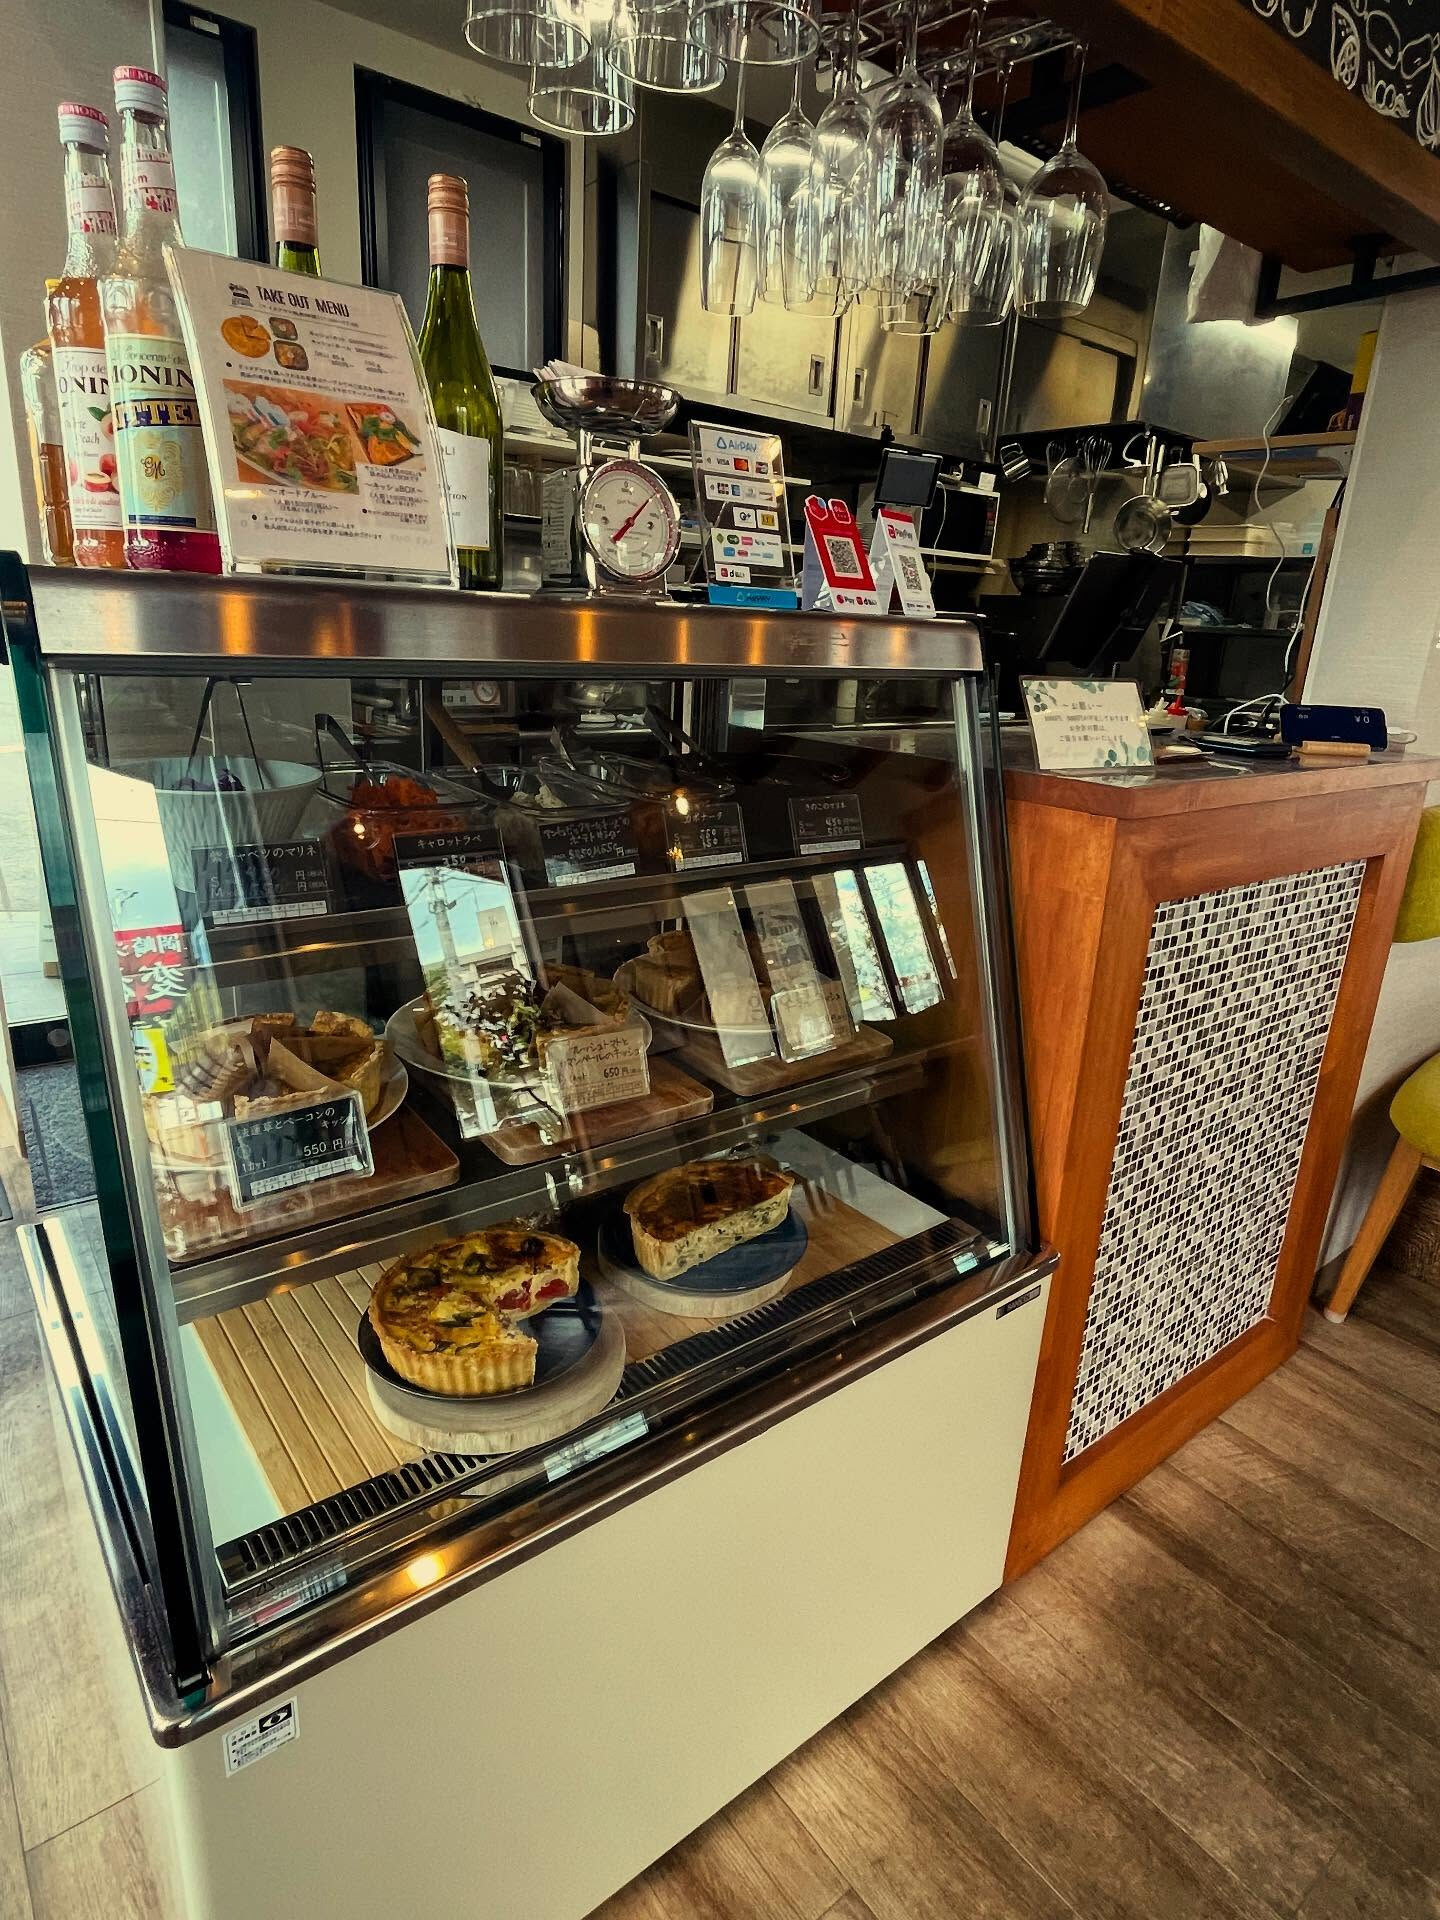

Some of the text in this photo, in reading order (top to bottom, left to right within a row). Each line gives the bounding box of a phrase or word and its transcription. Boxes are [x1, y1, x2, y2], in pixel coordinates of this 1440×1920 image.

[256, 285, 284, 306] TAKE
[288, 292, 309, 310] OUT
[315, 298, 350, 318] MENU
[603, 1066, 620, 1079] 650
[303, 1141, 327, 1158] 550
